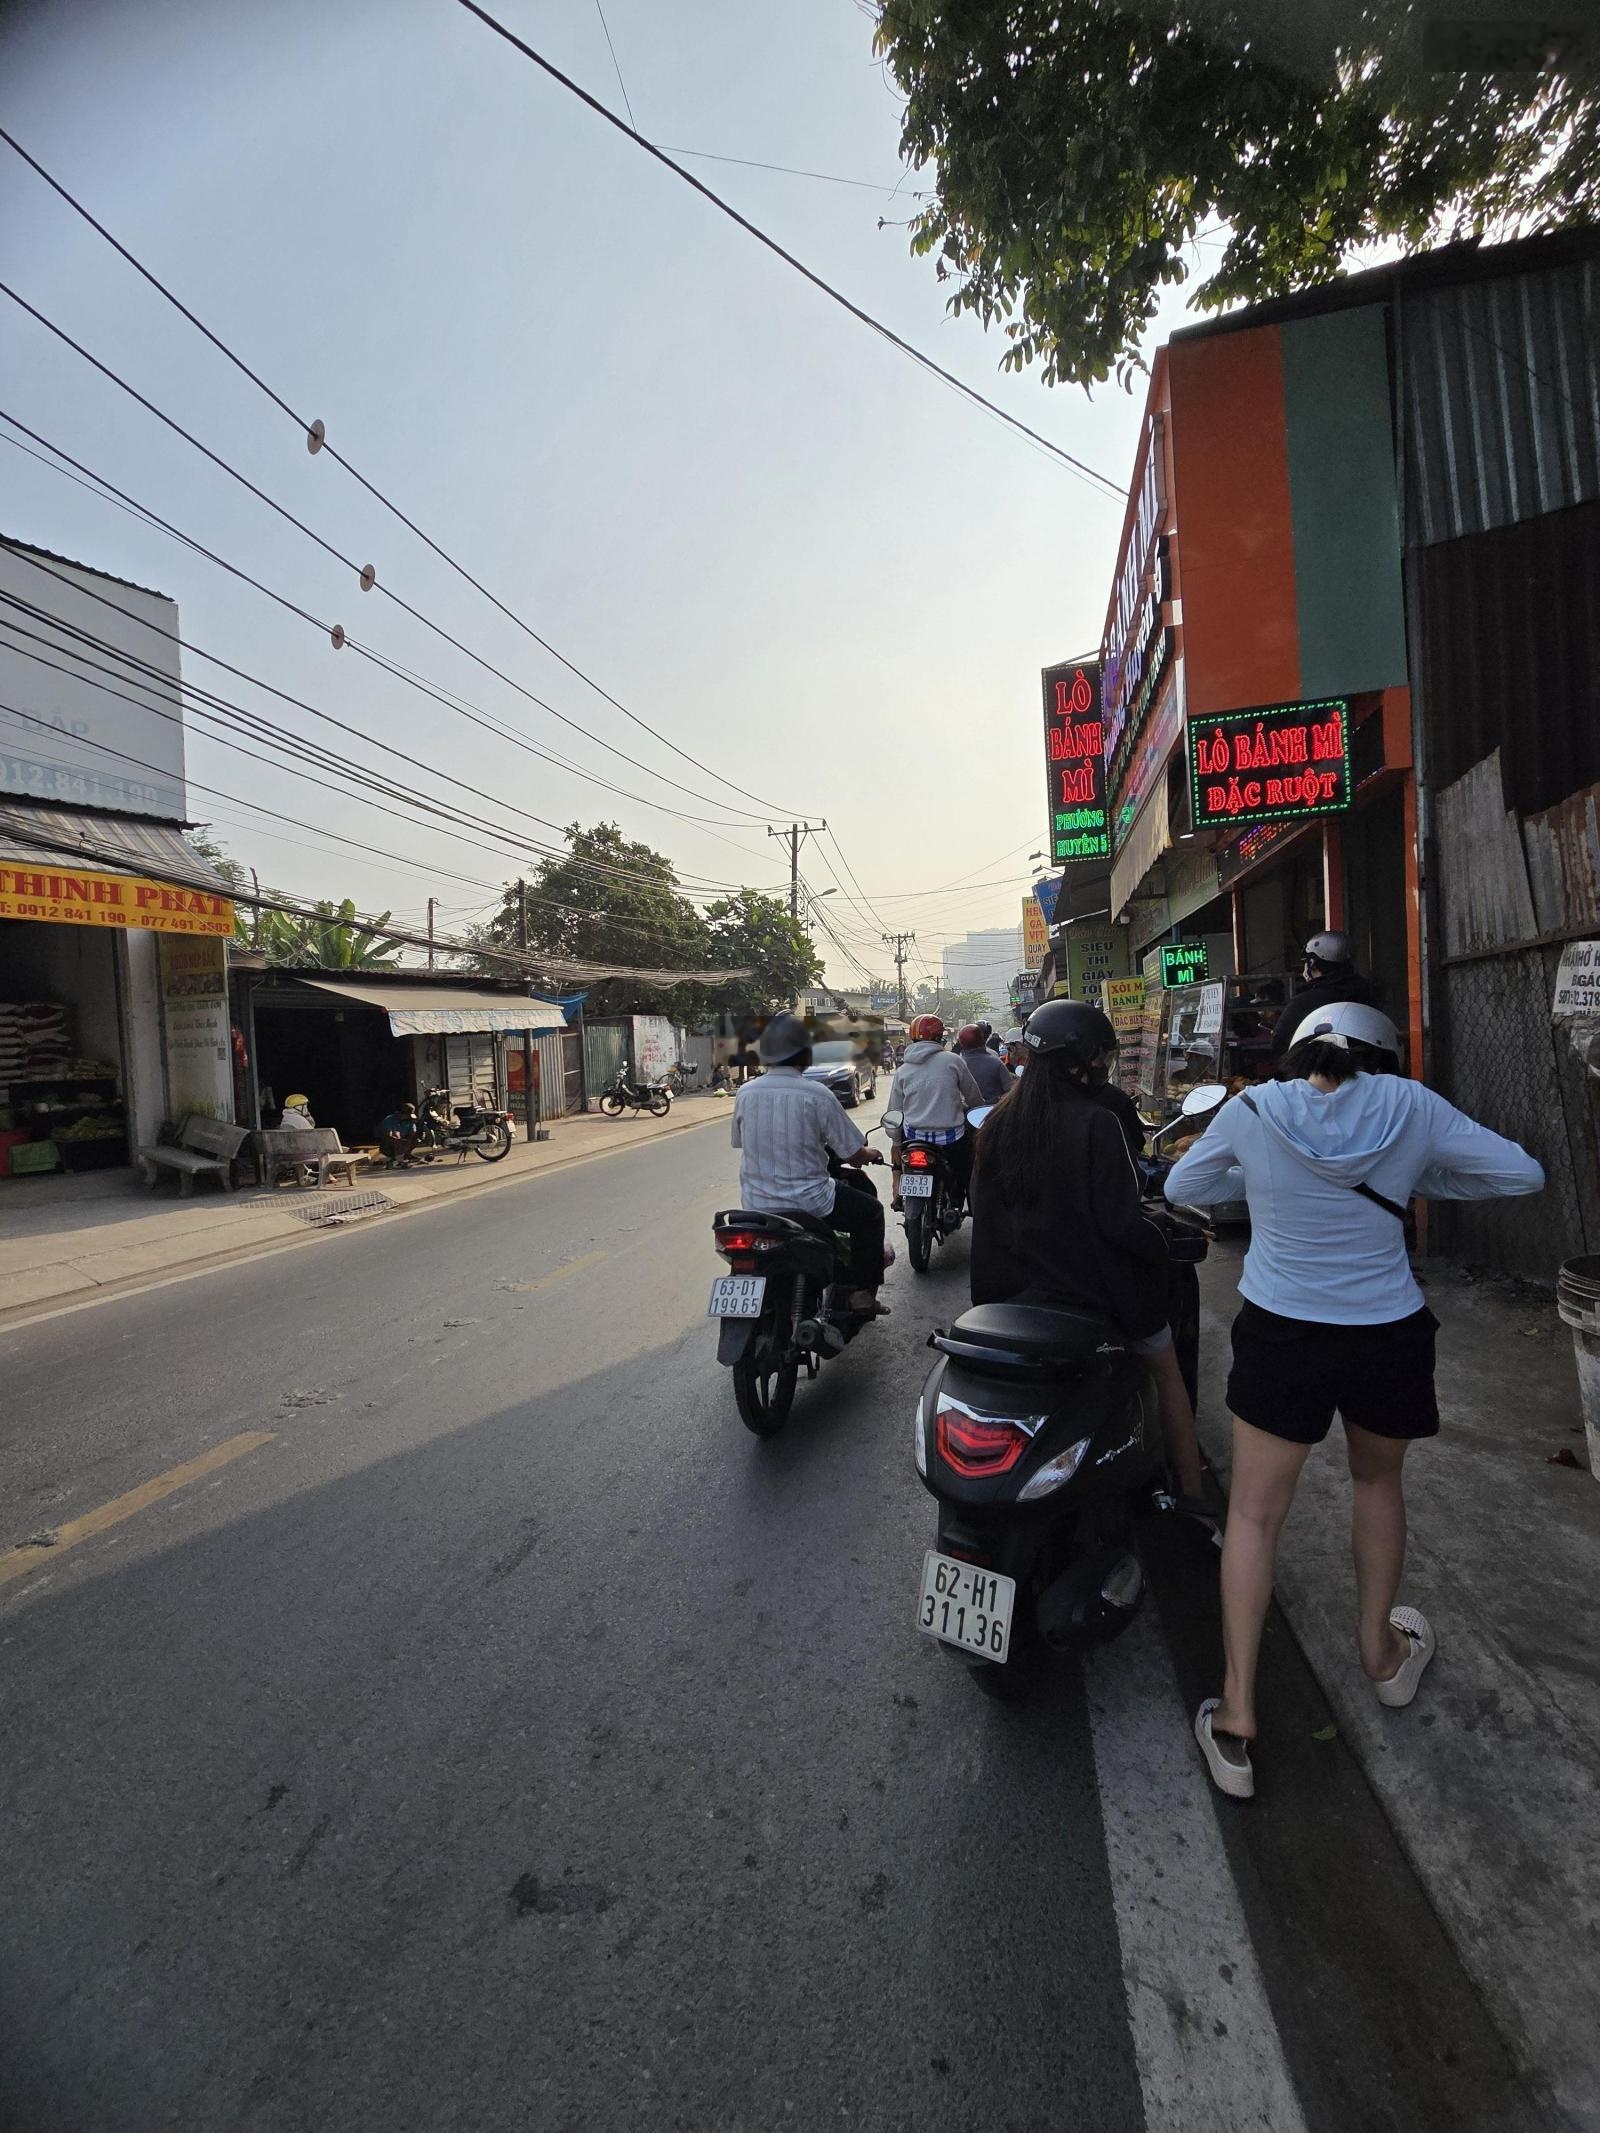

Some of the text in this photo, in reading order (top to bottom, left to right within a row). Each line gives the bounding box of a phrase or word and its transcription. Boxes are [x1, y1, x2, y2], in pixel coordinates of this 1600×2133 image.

[1056, 669, 1092, 715] LÒ
[1050, 716, 1103, 761] BÁNH
[1197, 728, 1230, 775] LÒ
[1234, 722, 1309, 771] BÁNH
[1312, 711, 1345, 761] MÌ
[1062, 758, 1096, 804] MÌ
[1208, 767, 1338, 815] ĐẶC RUỘT
[1101, 834, 1108, 853] 5
[17, 903, 59, 918] 0912
[64, 908, 92, 921] 841
[99, 911, 126, 924] 190
[140, 915, 166, 928] 077
[170, 918, 194, 931] 491
[1166, 949, 1204, 967] BÁNH
[1177, 967, 1195, 984] MÌ
[713, 1297, 759, 1314] 199.65
[719, 1280, 756, 1296] 63-D1
[935, 1562, 998, 1613] 62-H1
[923, 1595, 1004, 1653] 311.36
